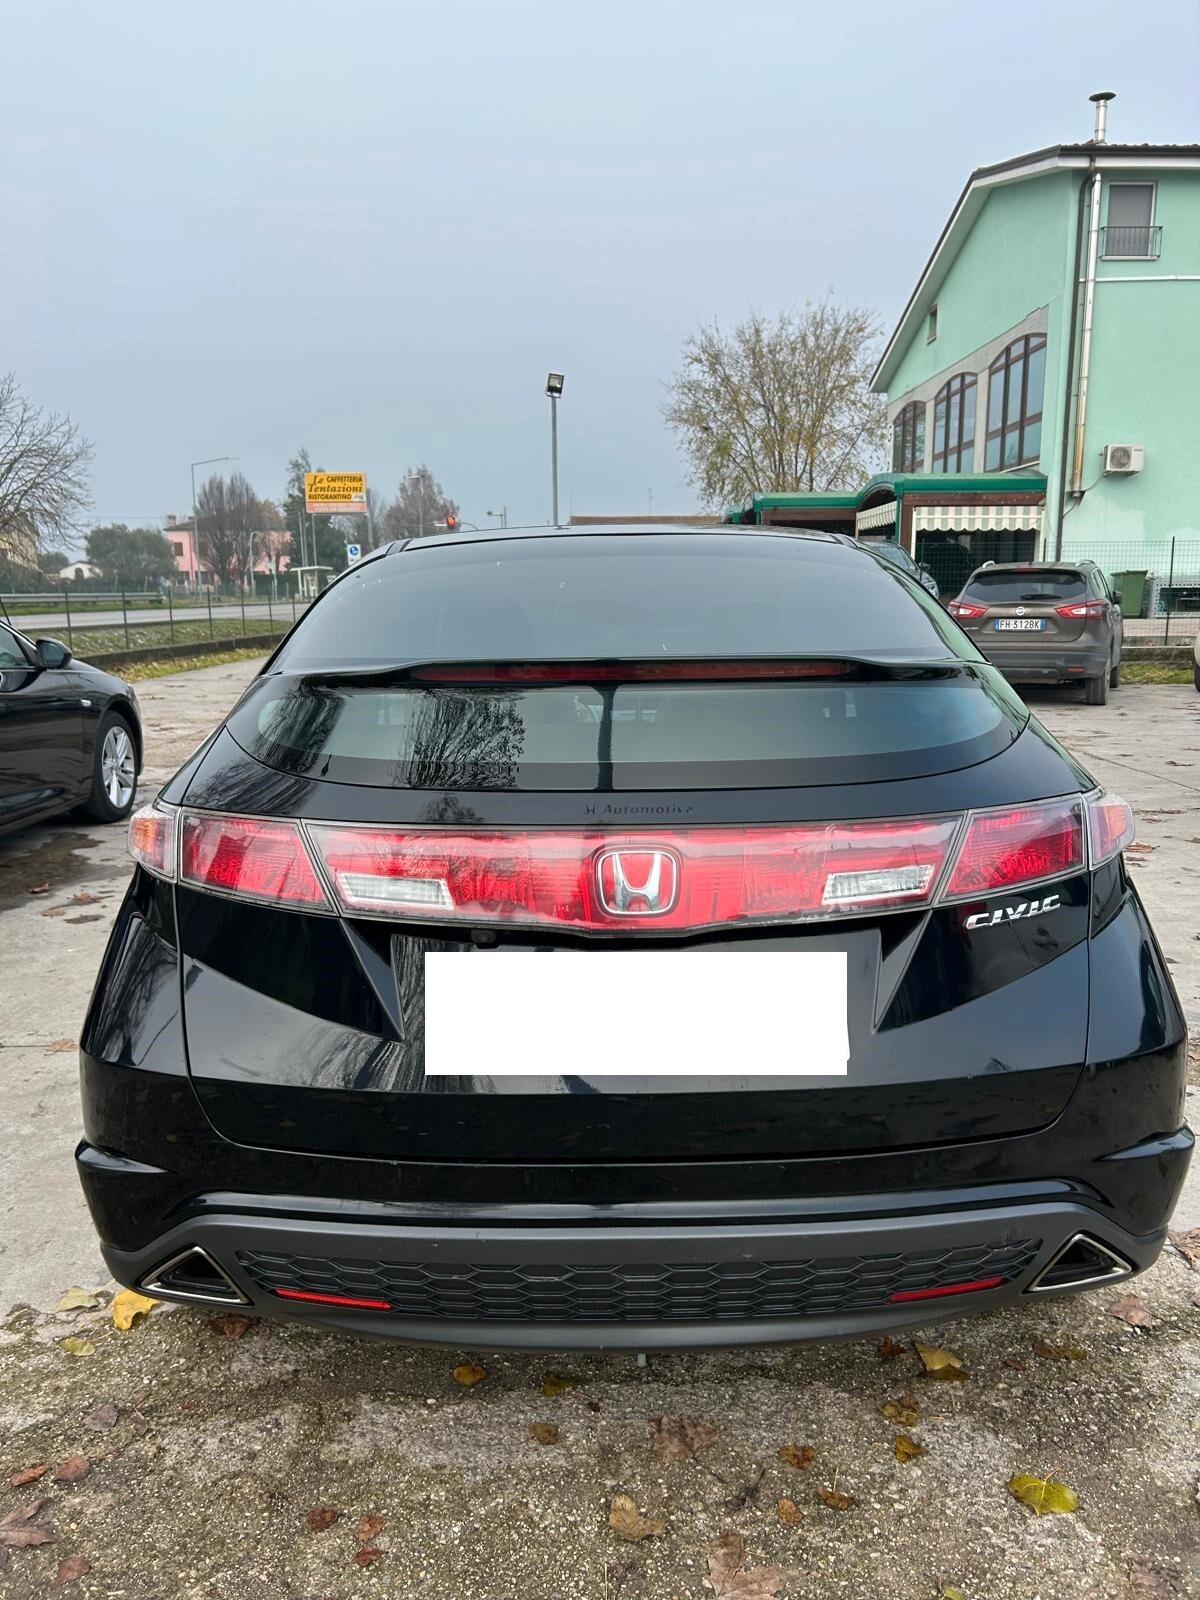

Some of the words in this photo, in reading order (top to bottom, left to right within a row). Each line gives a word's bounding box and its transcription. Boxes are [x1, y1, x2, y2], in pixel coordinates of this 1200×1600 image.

[312, 475, 324, 485] Le
[308, 483, 363, 492] Tentazioni
[1000, 620, 1011, 629] FH
[1013, 620, 1040, 629] 312BK
[965, 894, 1061, 930] CIVIC
